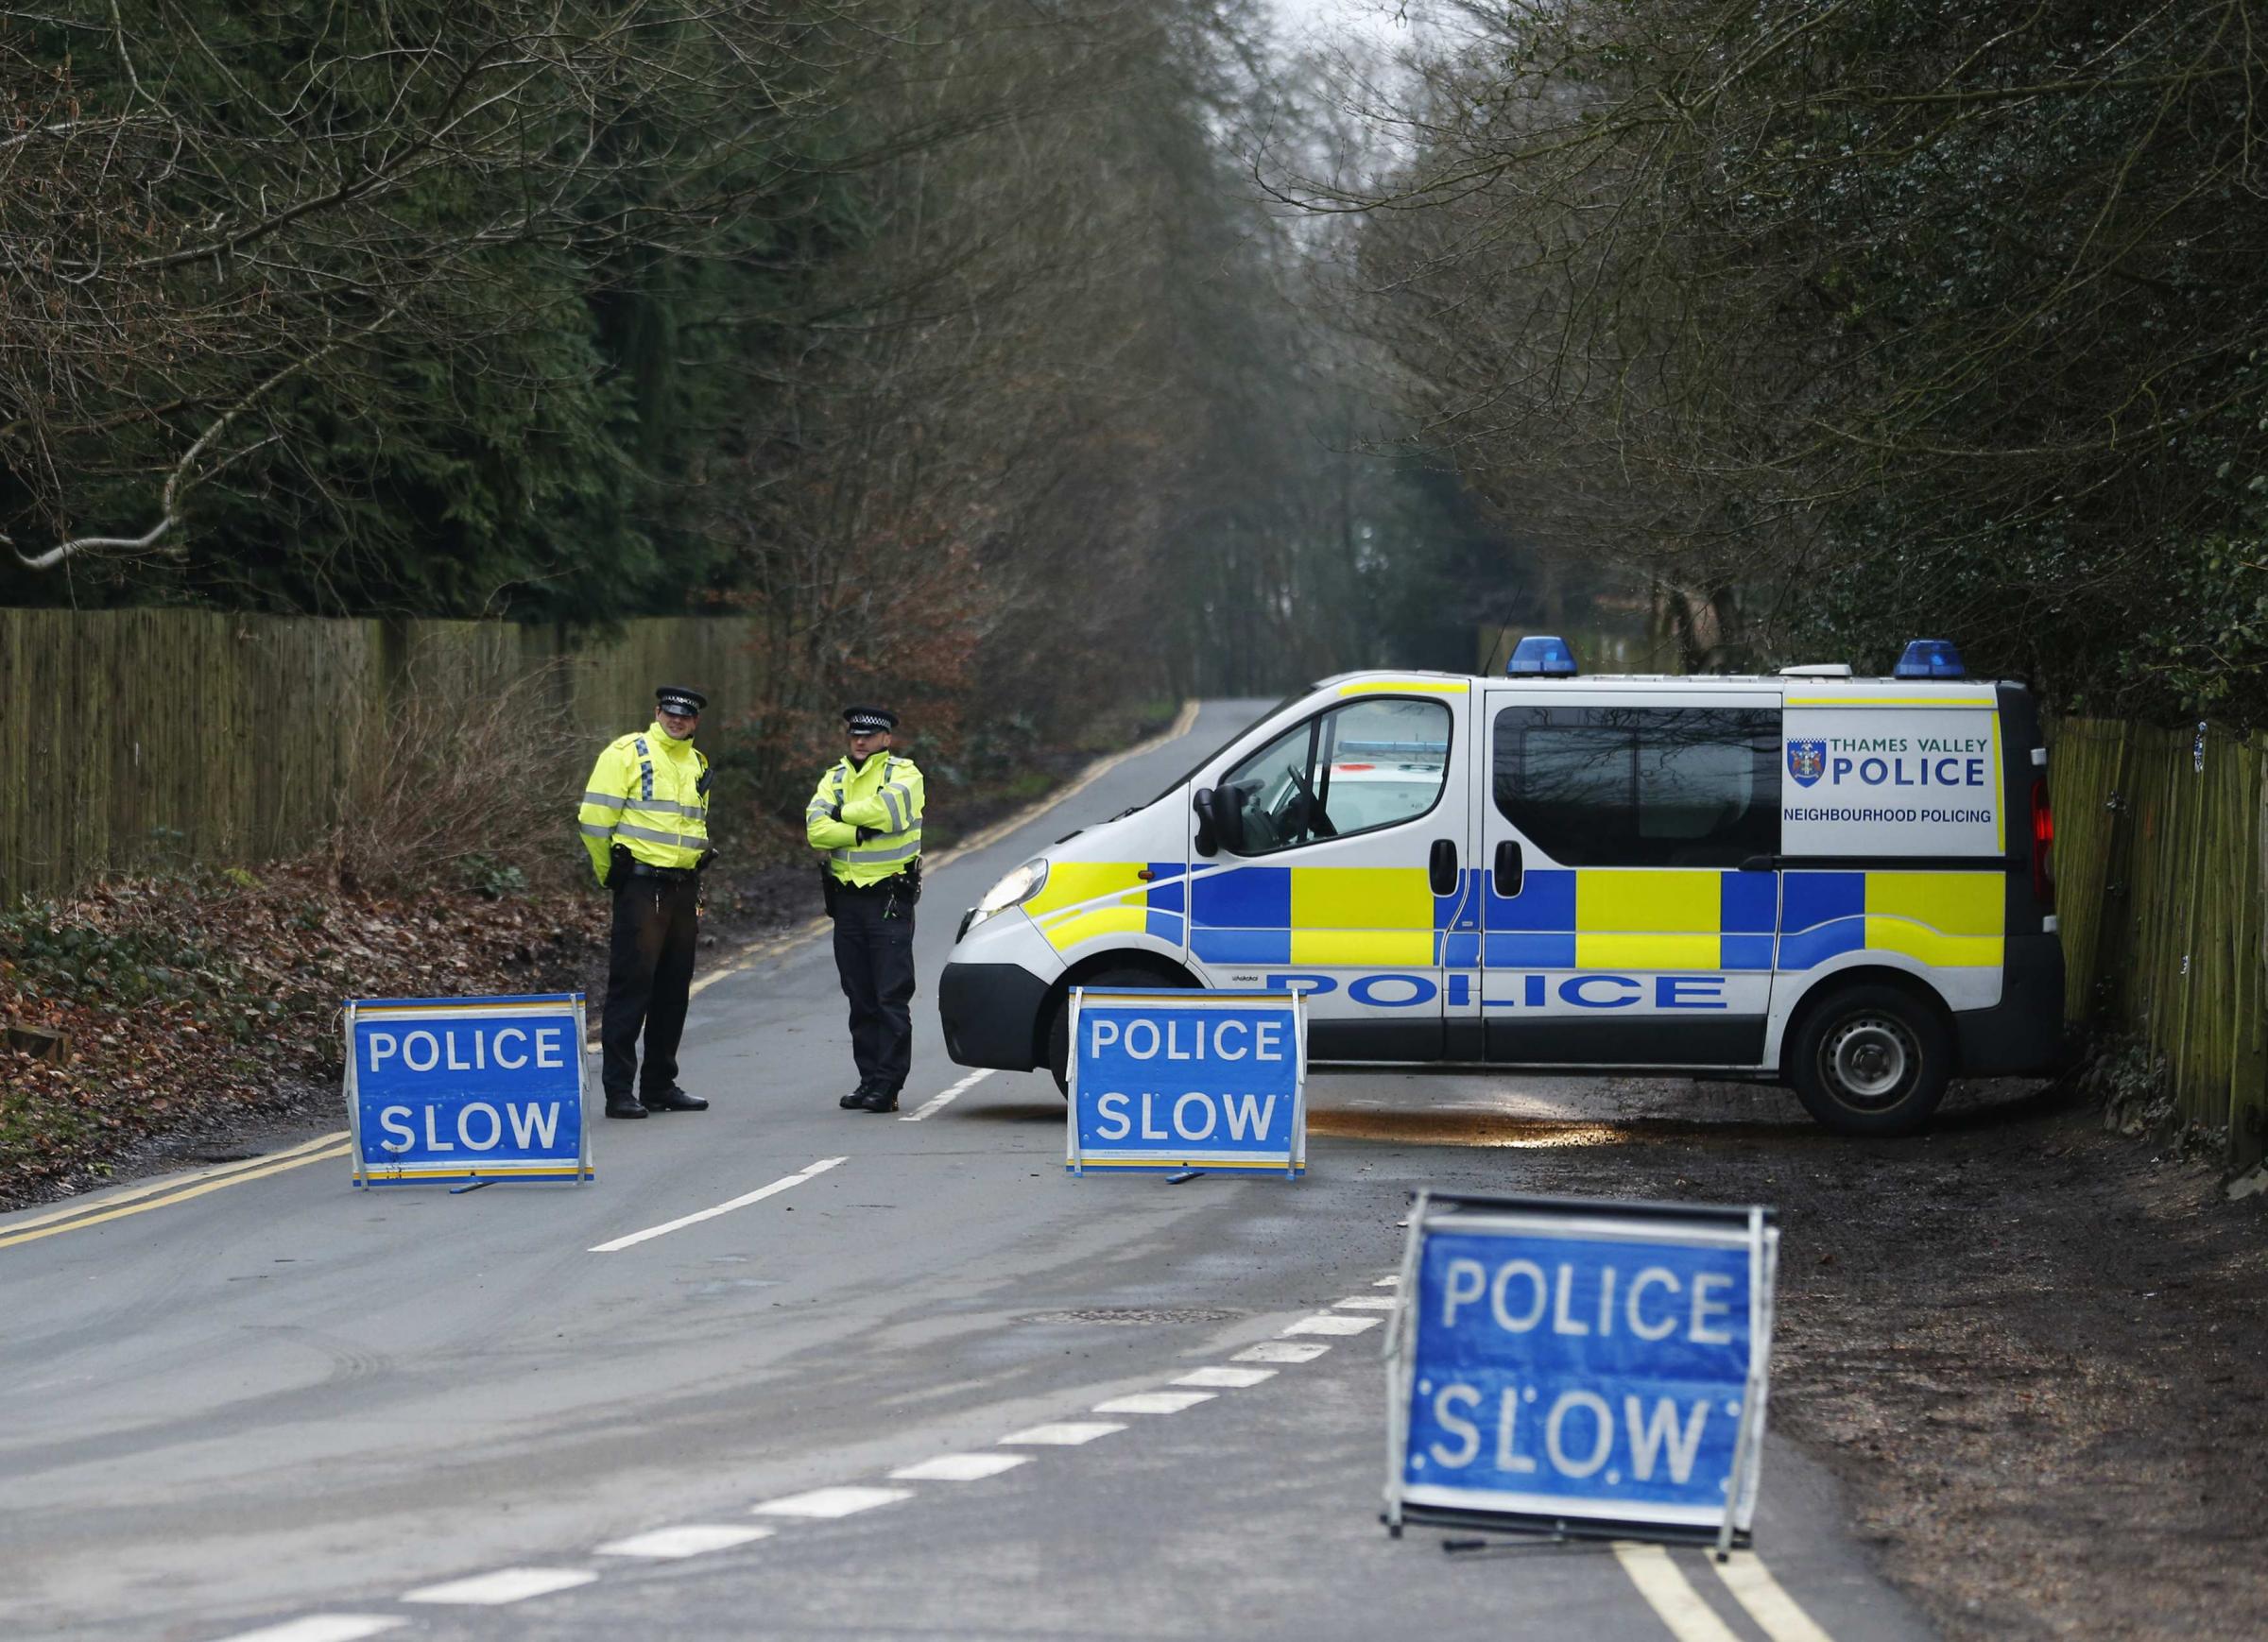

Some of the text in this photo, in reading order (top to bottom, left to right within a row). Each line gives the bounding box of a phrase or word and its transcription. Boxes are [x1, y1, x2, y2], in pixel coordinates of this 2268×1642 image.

[1830, 739, 1988, 753] THAMES VALLEY
[1832, 758, 1984, 786] POLICE
[1783, 808, 1991, 823] NEIGHBOURHOOD POLICING
[1266, 974, 1727, 1008] POLICE
[369, 1028, 564, 1072] POLICE
[1091, 1018, 1282, 1061] POLICE
[380, 1102, 560, 1153] SLOW
[1095, 1091, 1277, 1140] SLOW
[1443, 1257, 1735, 1345] POLICE
[1429, 1382, 1711, 1485] SLOW
